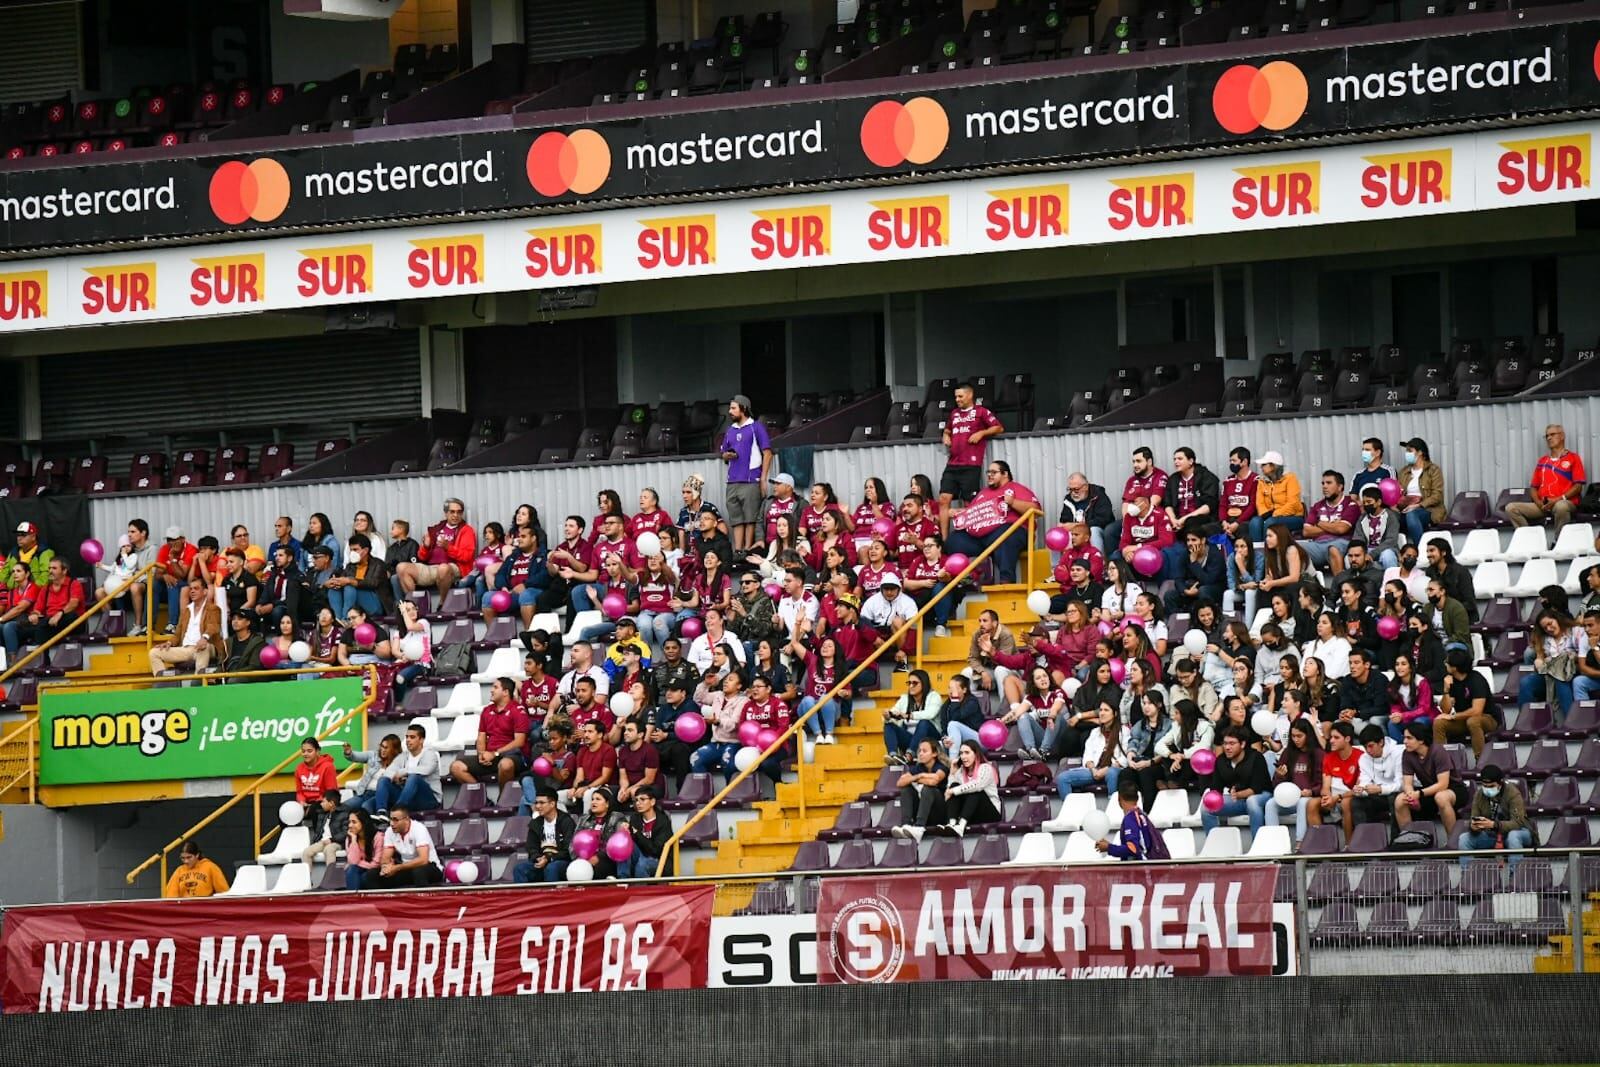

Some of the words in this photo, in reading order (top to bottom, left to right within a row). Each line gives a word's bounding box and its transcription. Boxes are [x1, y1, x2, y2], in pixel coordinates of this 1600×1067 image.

[1327, 47, 1550, 102] mastercard
[967, 85, 1173, 137] mastercard
[628, 120, 822, 169] mastercard
[306, 151, 493, 197] mastercard
[1362, 162, 1443, 207] SUR
[1499, 148, 1582, 194] SUR
[988, 196, 1061, 240] SUR
[1109, 186, 1186, 229] SUR
[1233, 174, 1312, 219] SUR
[639, 227, 709, 268] SUR
[752, 217, 824, 259] SUR
[870, 207, 941, 249] SUR
[299, 256, 367, 296] SUR
[409, 247, 478, 287] SUR
[527, 236, 595, 277] SUR
[84, 275, 149, 314] SUR
[192, 265, 257, 305] SUR
[1235, 482, 1243, 493] S
[52, 709, 190, 754] monge
[241, 716, 309, 742] tengo
[847, 911, 884, 971] S
[914, 884, 1087, 957] AMOR
[1107, 882, 1255, 950] REAL
[38, 938, 177, 1012] NUNCA
[194, 934, 288, 1006] MAS
[307, 906, 498, 1002] JUGARÁN
[516, 922, 655, 995] SOLAS
